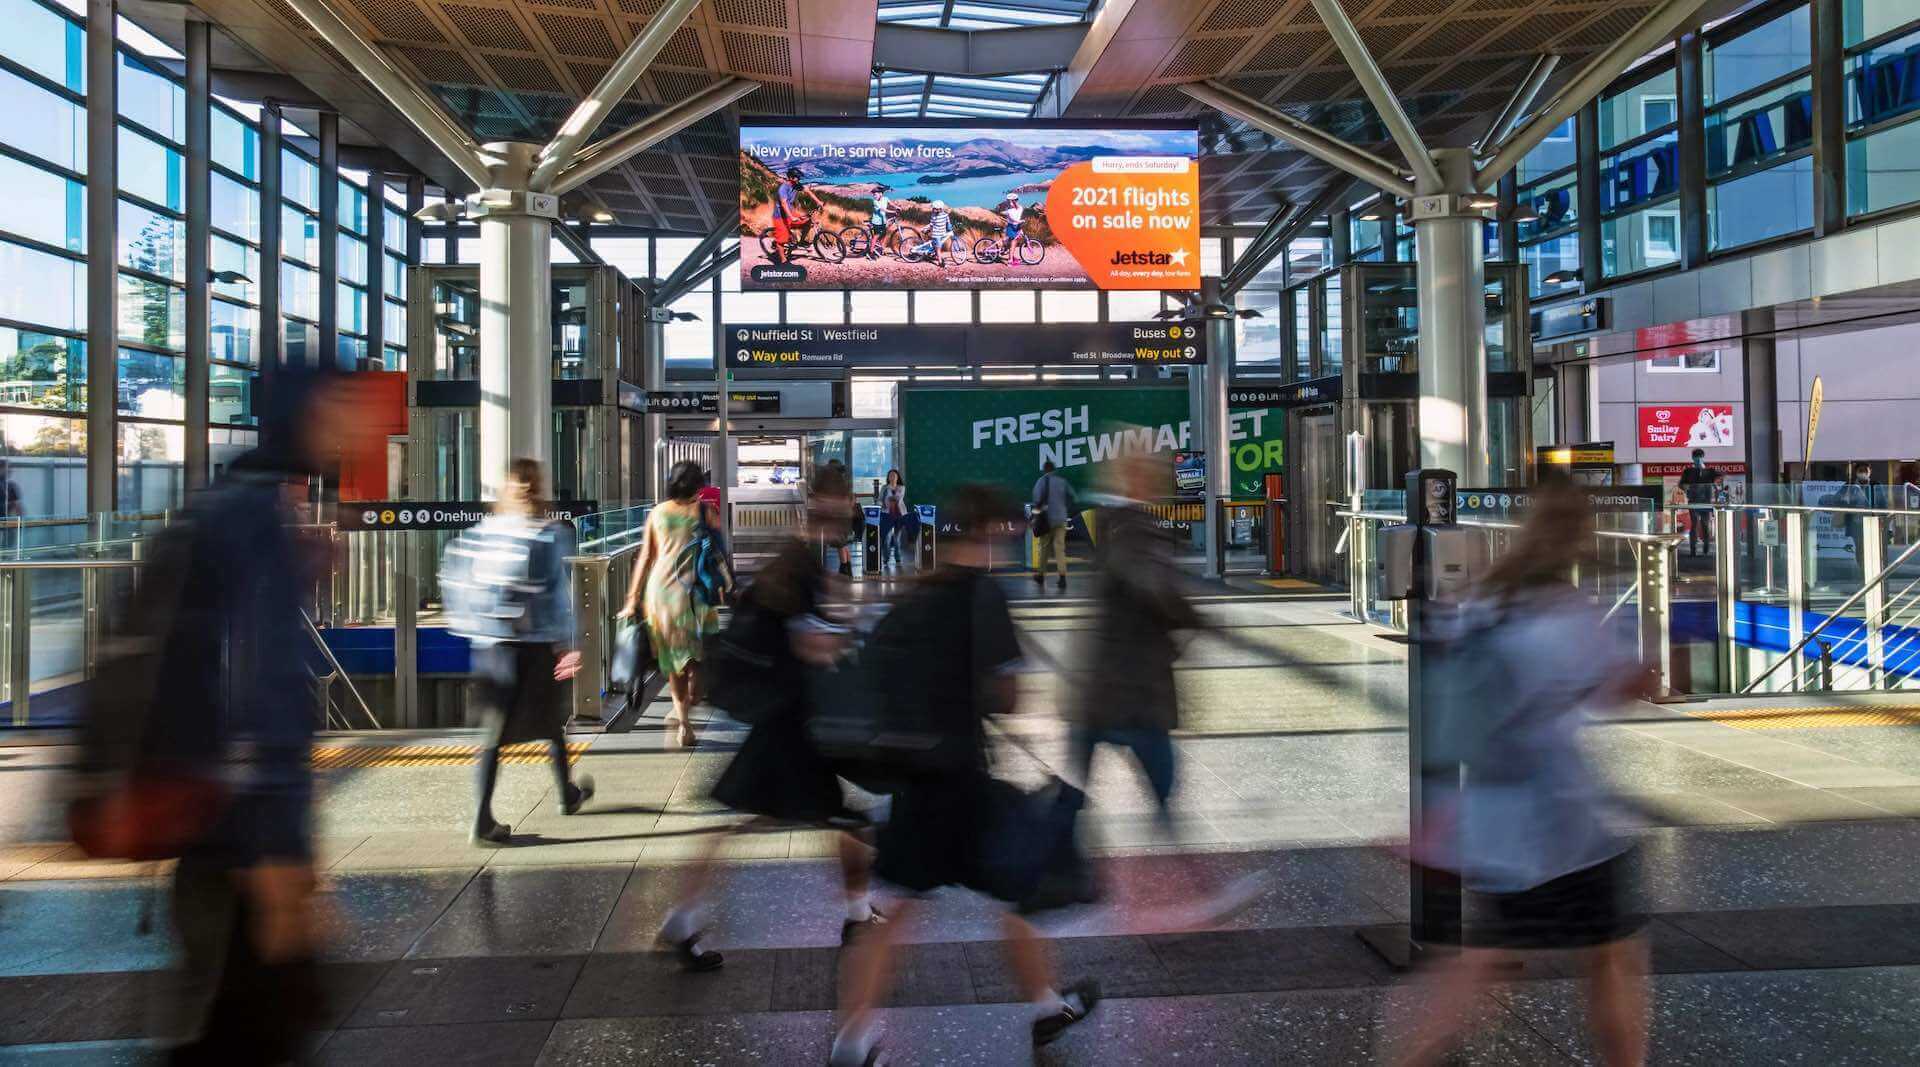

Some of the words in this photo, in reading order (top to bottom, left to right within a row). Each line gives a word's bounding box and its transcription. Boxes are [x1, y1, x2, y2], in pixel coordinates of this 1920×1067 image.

[750, 144, 781, 158] New
[784, 146, 817, 161] year.
[821, 144, 846, 158] The
[849, 146, 886, 158] same
[890, 144, 913, 158] low
[916, 144, 955, 158] fares.
[1072, 187, 1118, 206] 2021
[1123, 187, 1191, 212] flights
[1072, 214, 1097, 229] on
[1102, 210, 1144, 229] sale
[1110, 250, 1172, 266] Jetstar
[760, 269, 799, 280] jetstar.com
[752, 329, 798, 341] Nuffield
[800, 329, 813, 341] St
[823, 329, 878, 341] Westfield
[1133, 327, 1167, 339] Buses
[752, 350, 777, 363] Way
[780, 351, 800, 361] out
[802, 353, 832, 361] Remuera
[833, 353, 843, 361] Rd
[1101, 352, 1135, 360] Broadway
[1135, 348, 1160, 360] Way
[1162, 348, 1181, 359] out
[972, 405, 1089, 449] FRESH
[1647, 424, 1680, 434] Smiley
[1650, 434, 1677, 443] Dairy
[1647, 465, 1662, 473] ICE
[1663, 465, 1684, 473] CRE
[1514, 494, 1536, 509] City
[1589, 494, 1639, 505] Swanson
[434, 510, 494, 521] Onehun
